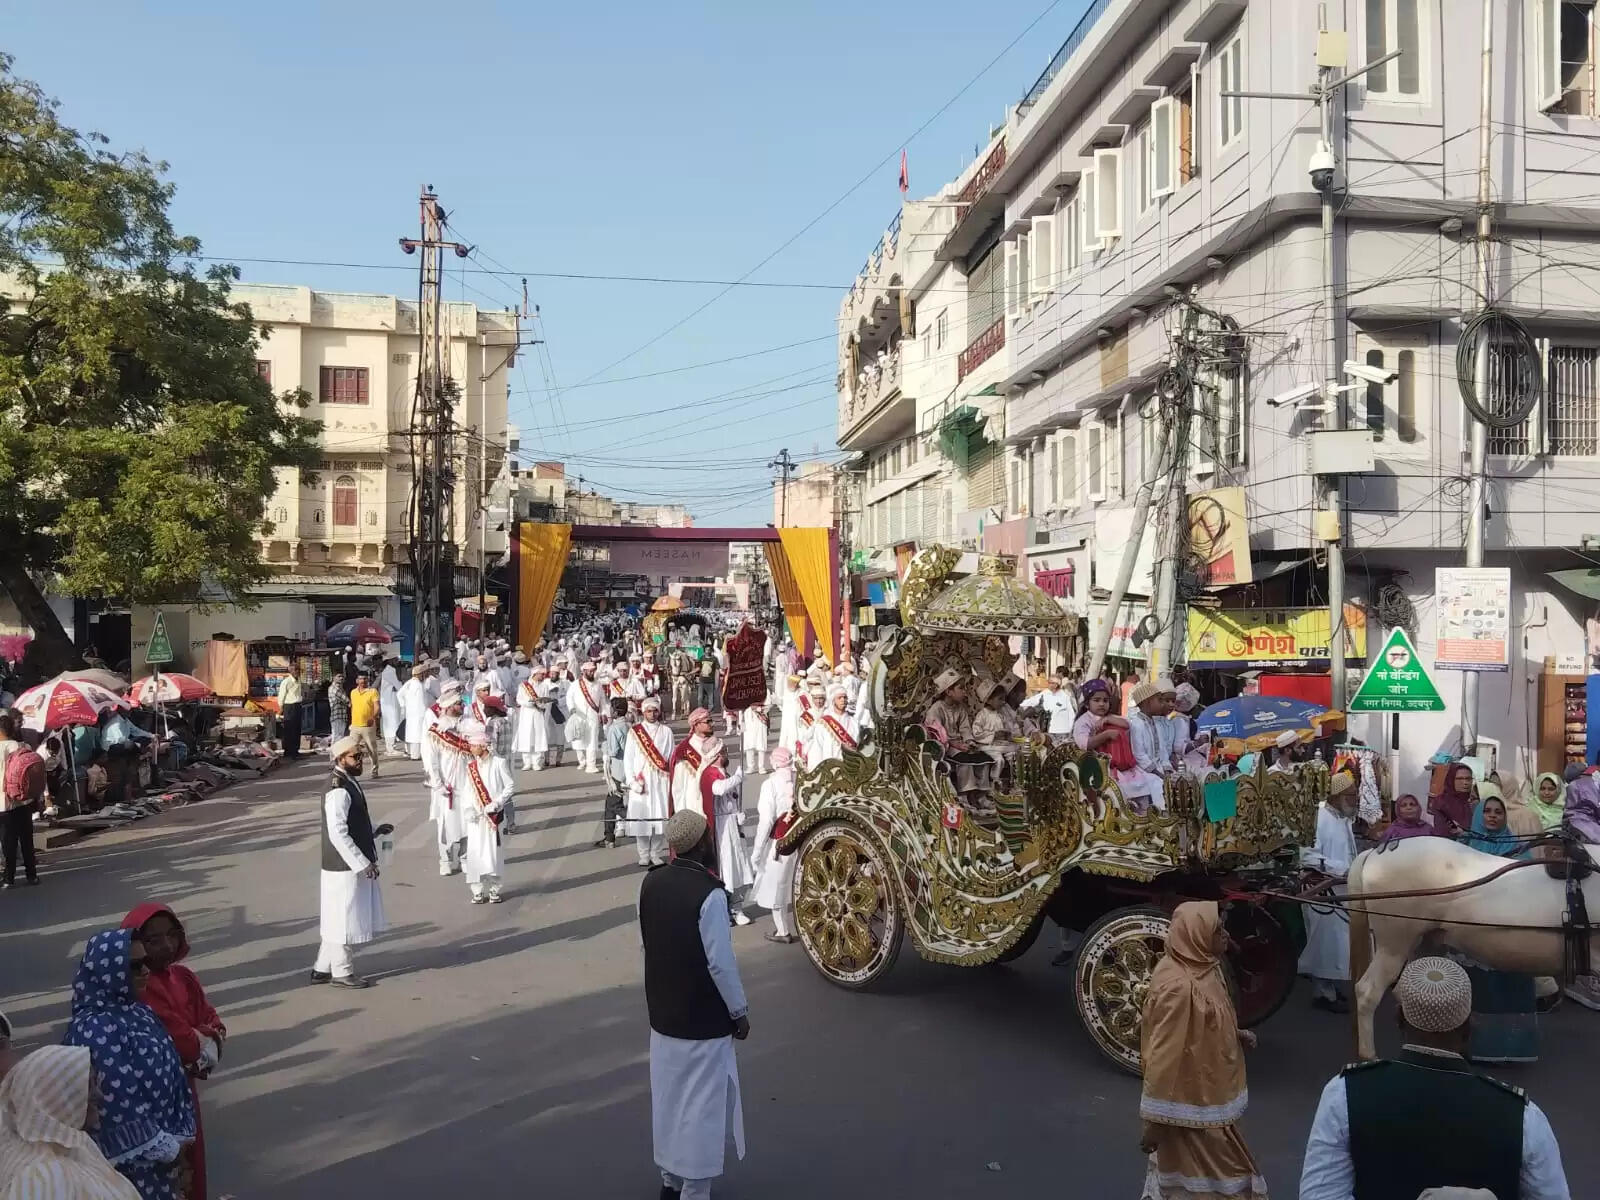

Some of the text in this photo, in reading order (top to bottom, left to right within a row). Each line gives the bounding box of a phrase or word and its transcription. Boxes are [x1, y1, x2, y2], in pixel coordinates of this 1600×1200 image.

[1226, 631, 1296, 657] गणेश
[1376, 669, 1388, 680] नो
[1388, 683, 1408, 694] जोन
[1363, 699, 1379, 707] नगर
[1406, 700, 1434, 710] उदयपुर
